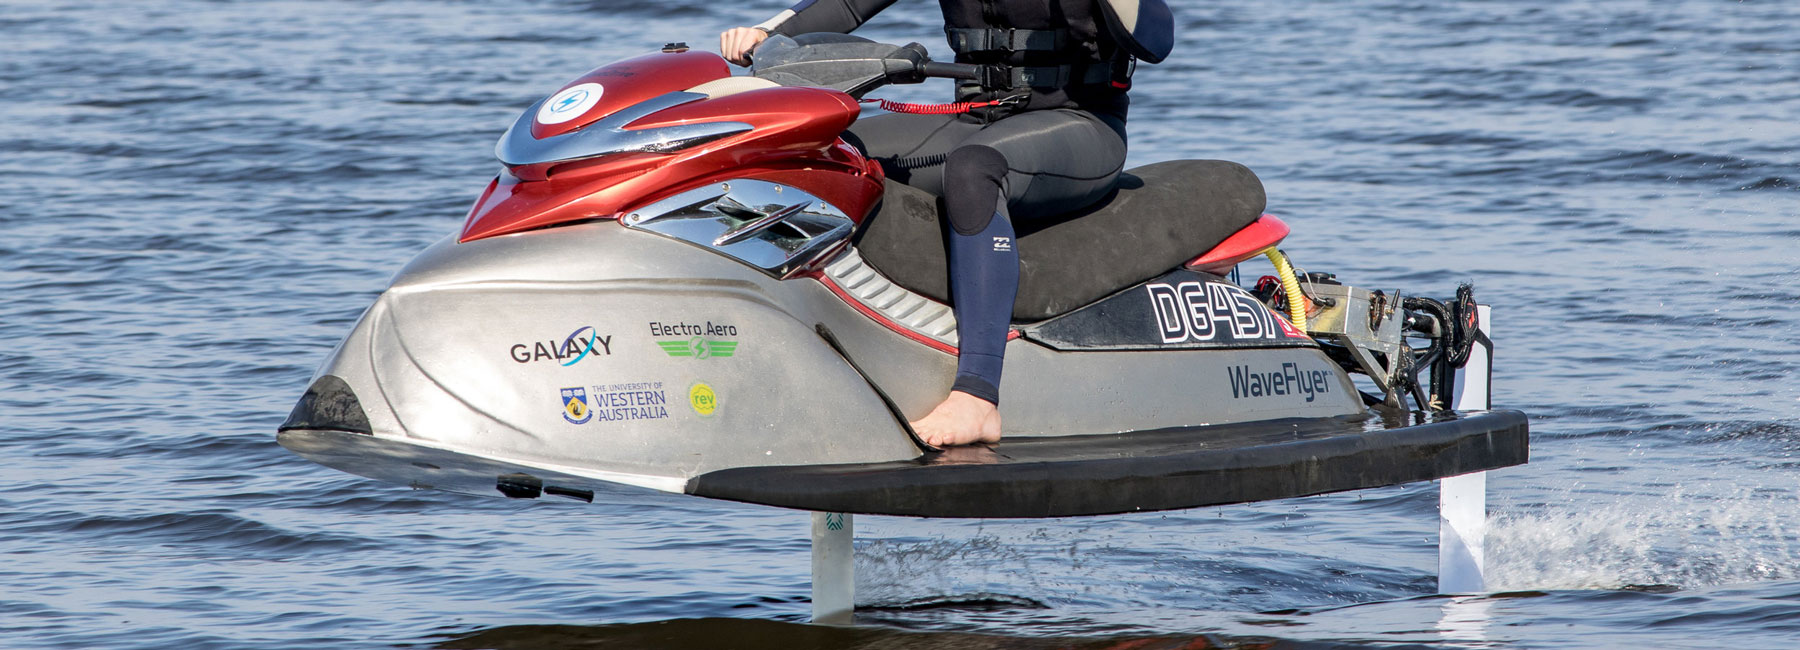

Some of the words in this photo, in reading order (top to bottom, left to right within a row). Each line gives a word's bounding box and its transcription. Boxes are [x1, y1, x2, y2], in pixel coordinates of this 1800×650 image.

[1146, 281, 1276, 343] DG457
[650, 320, 738, 337] Electro.Aero
[510, 334, 613, 364] GALAXY
[609, 383, 652, 392] UNIVERSITY
[1227, 362, 1330, 402] WaveFlyer
[594, 390, 666, 407] WESTERN
[694, 394, 714, 405] rev
[598, 406, 669, 422] AUSTRALIA
